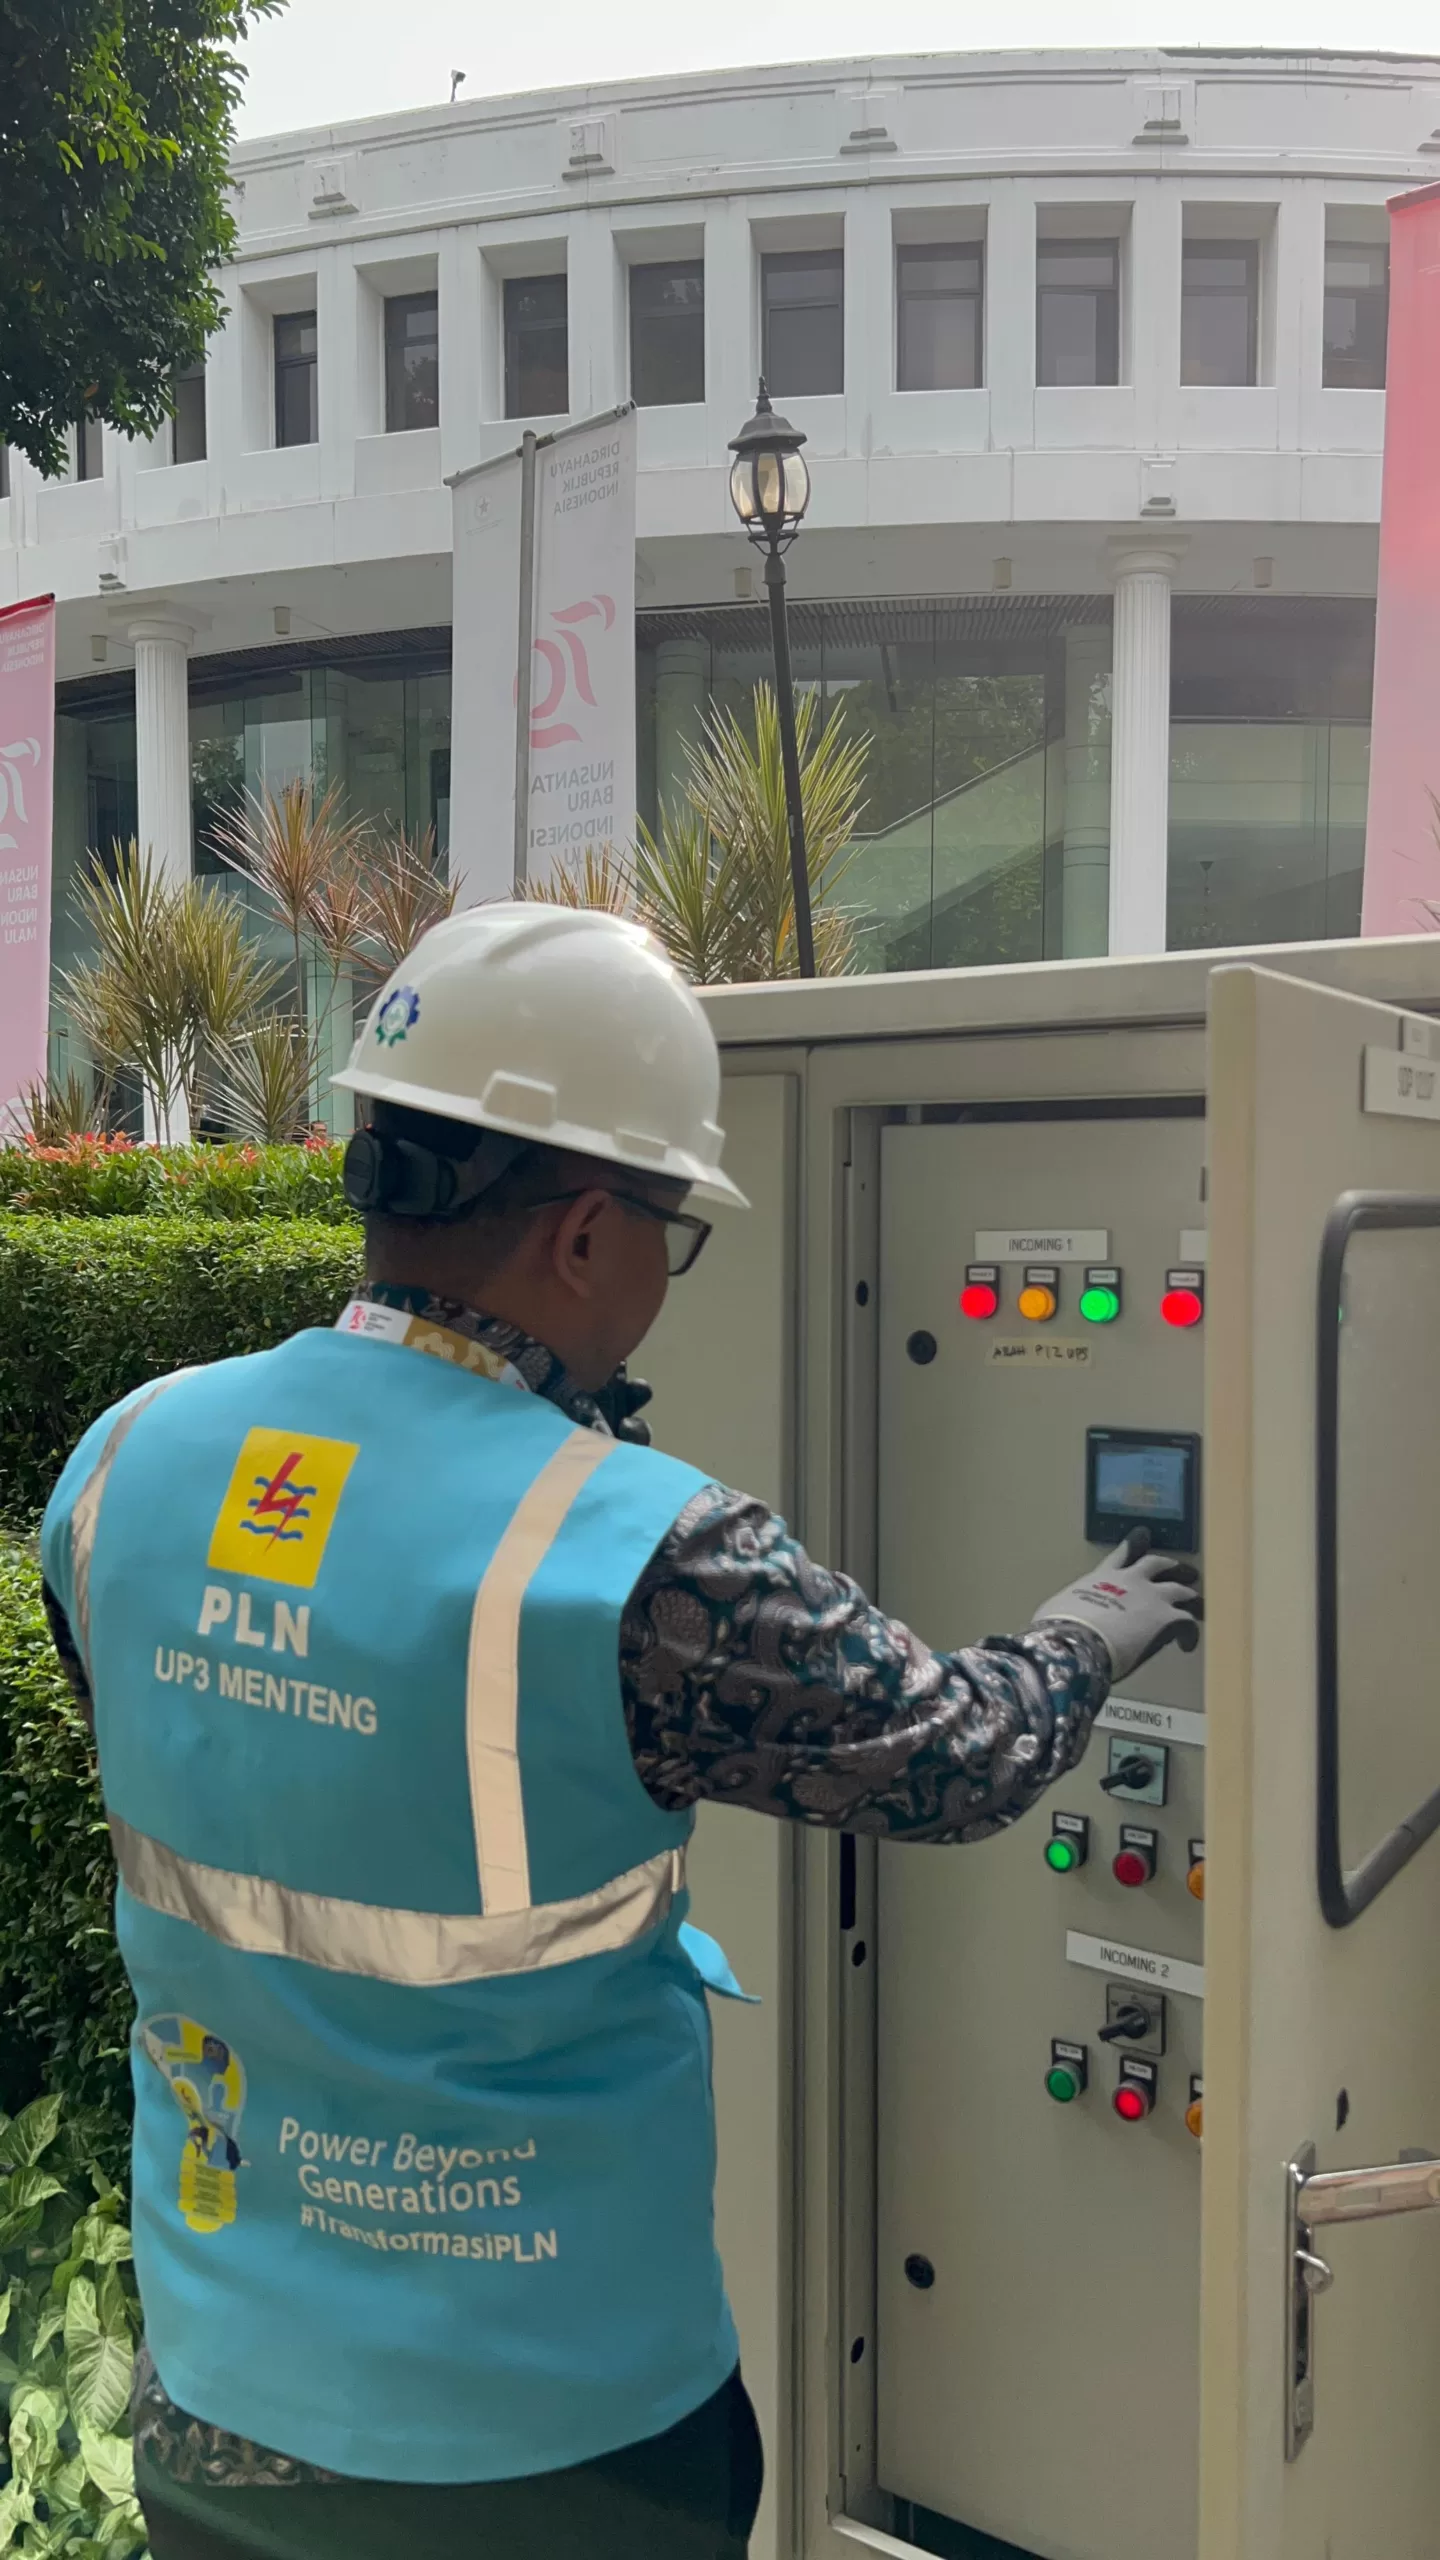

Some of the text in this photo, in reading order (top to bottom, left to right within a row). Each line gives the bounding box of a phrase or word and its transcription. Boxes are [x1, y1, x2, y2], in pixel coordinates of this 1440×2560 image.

[1008, 1237, 1073, 1252] INCOMING 1
[197, 1585, 310, 1658] PLN
[154, 1646, 378, 1735] UP3 MENTENG
[1104, 1703, 1173, 1729] INCOMING 1
[1100, 1946, 1170, 1978] INCOMING 2
[278, 2116, 537, 2180] Power Beyond
[298, 2164, 521, 2214] Generations
[301, 2204, 559, 2263] #TransformasiPLN
